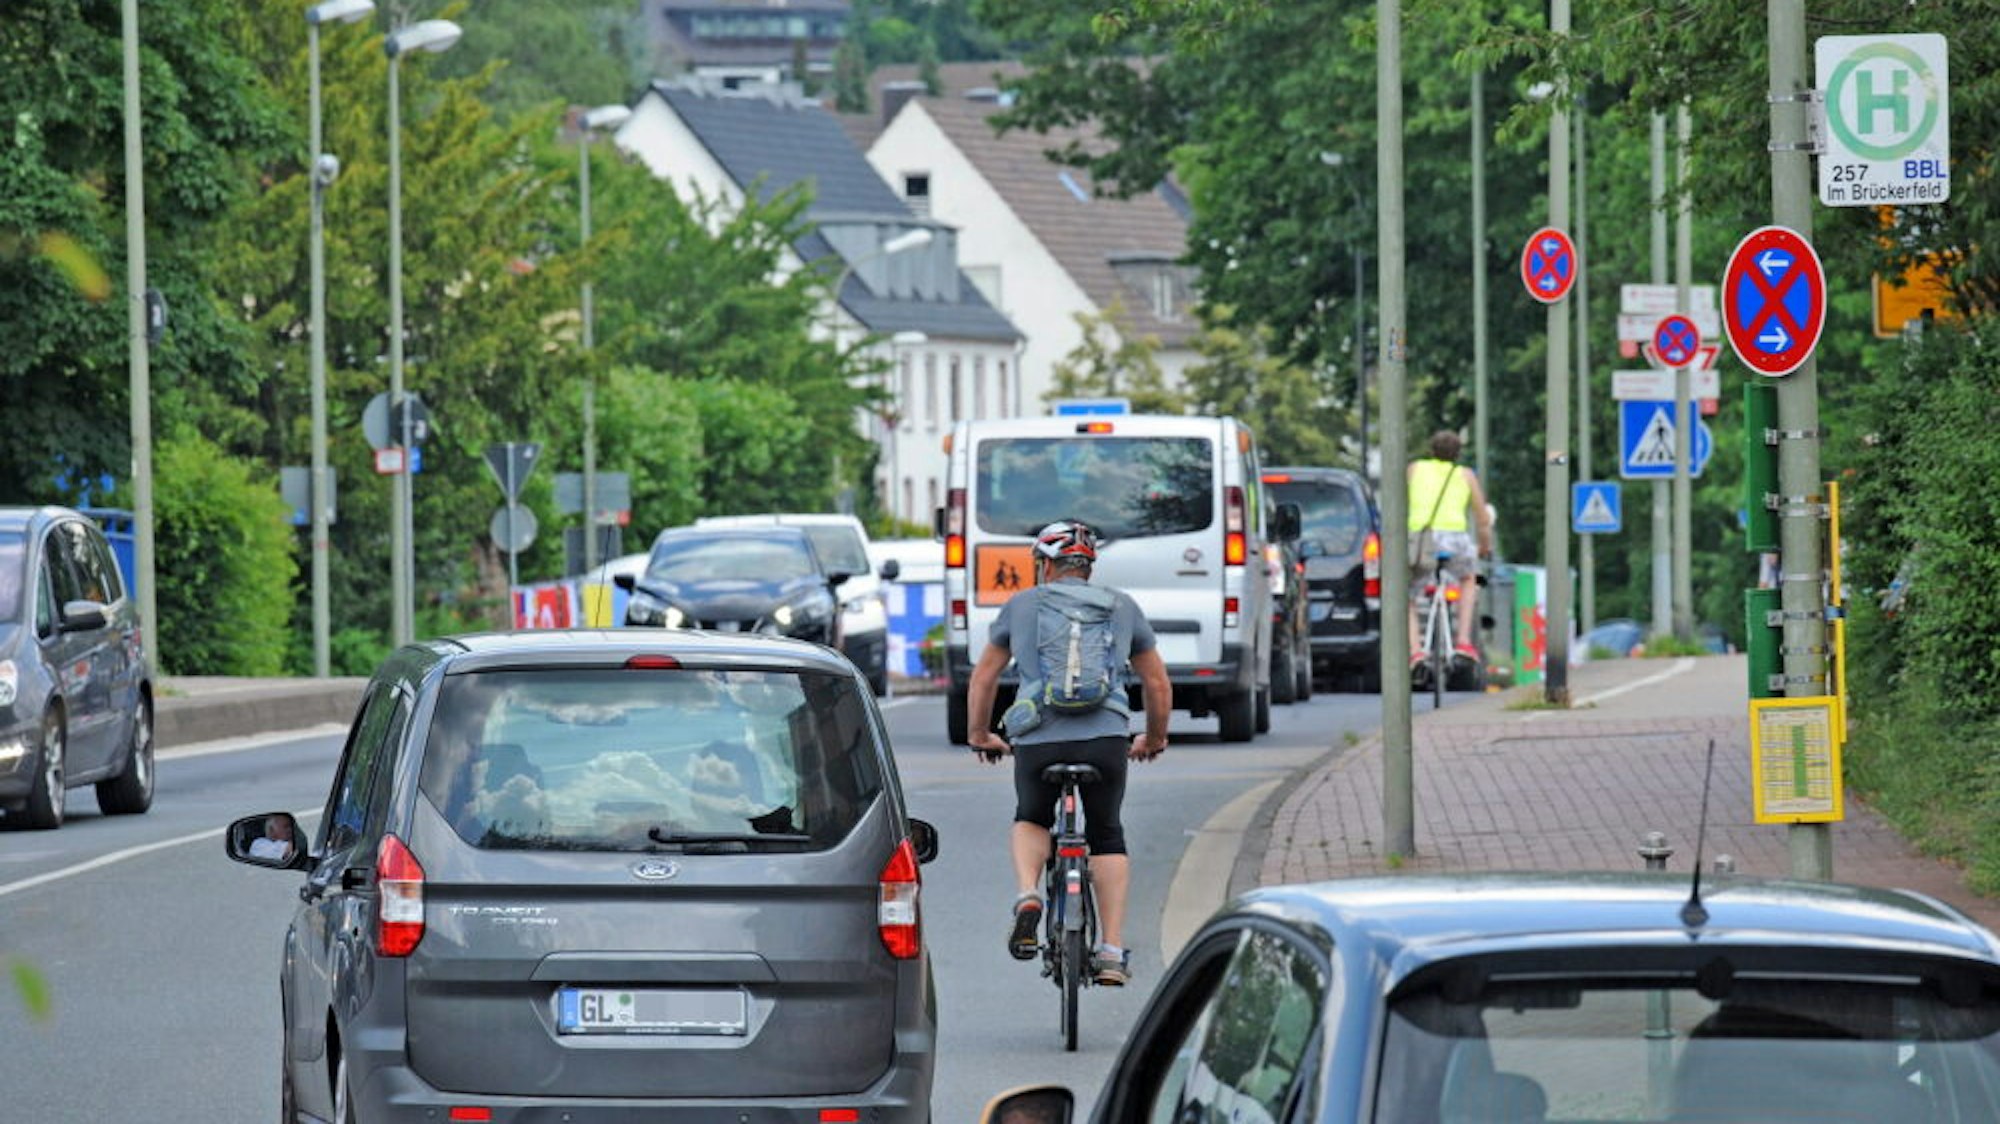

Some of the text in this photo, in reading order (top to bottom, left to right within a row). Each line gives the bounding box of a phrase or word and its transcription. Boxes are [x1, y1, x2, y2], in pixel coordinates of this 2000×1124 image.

[1856, 70, 1909, 134] H
[1832, 165, 1869, 182] 257
[1904, 160, 1947, 178] BBL
[1827, 181, 1942, 201] Im Brückerfeld
[581, 995, 614, 1022] GL
